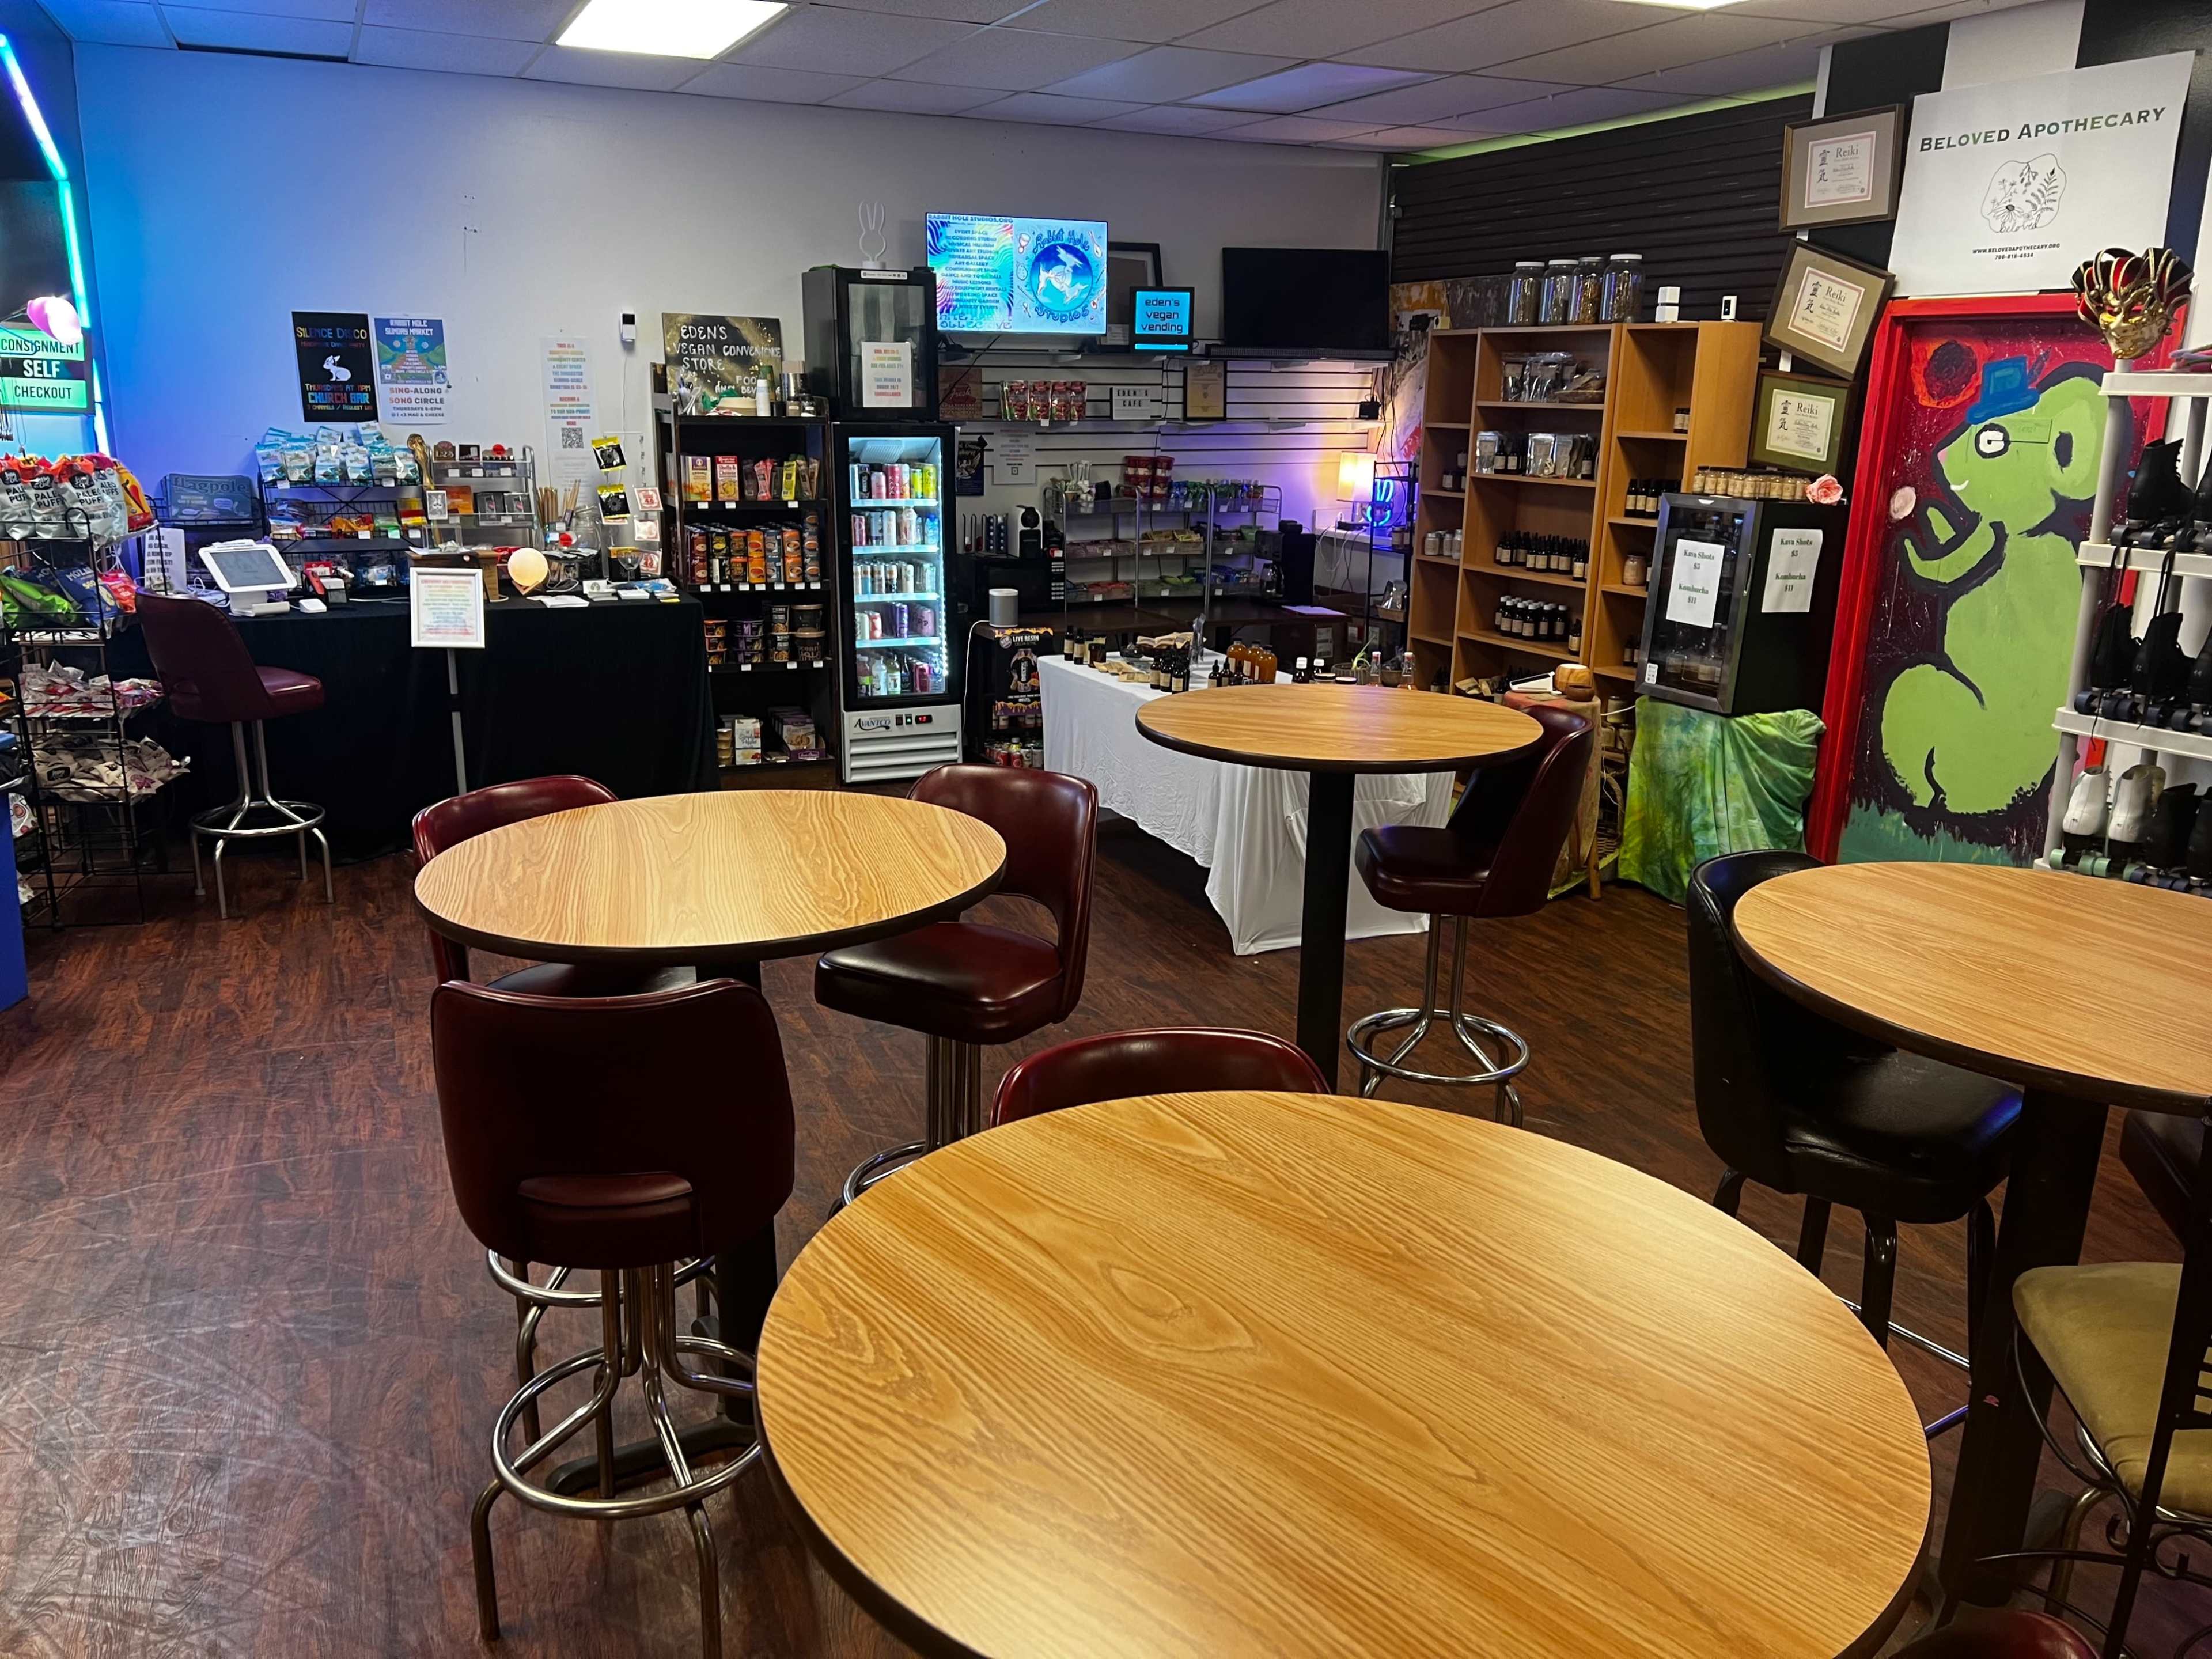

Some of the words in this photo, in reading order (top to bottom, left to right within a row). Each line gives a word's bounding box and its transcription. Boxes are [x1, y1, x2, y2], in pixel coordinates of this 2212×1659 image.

[1919, 129, 2010, 152] BELOVED
[2017, 107, 2166, 139] APOTHECARY
[1836, 144, 1858, 158] Reiki
[2000, 214, 2041, 233] beloved
[1032, 228, 1064, 253] Rabbit
[1068, 230, 1090, 251] Hole
[1825, 286, 1847, 302] Reiki
[1145, 298, 1180, 306] eden's
[1146, 312, 1179, 321] vegan
[296, 327, 333, 338] SILENCE
[336, 328, 367, 339] DISCO
[681, 324, 727, 340] EDEN'S
[1141, 323, 1183, 334] vending
[1, 339, 80, 354] CONSIGNMENT
[673, 342, 715, 355] VEGAN
[23, 359, 60, 378] SELF
[683, 357, 725, 370] STORE
[736, 376, 757, 385] FOO
[14, 385, 71, 399] CHECKOUT
[305, 383, 343, 391] THURSDAYS
[308, 392, 347, 403] CHURCH
[350, 393, 370, 404] BAR
[1797, 402, 1818, 415] Reiki
[6, 486, 25, 496] PAL
[175, 476, 245, 494] flagpole
[35, 490, 57, 501] PALE
[79, 496, 104, 505] PUFF
[1683, 549, 1696, 558] Kava
[1698, 552, 1715, 560] Shots
[66, 567, 94, 581] MOZA
[1679, 583, 1709, 594] Kombucha
[1687, 596, 1696, 604] $11
[854, 718, 891, 729] AVANTCO
